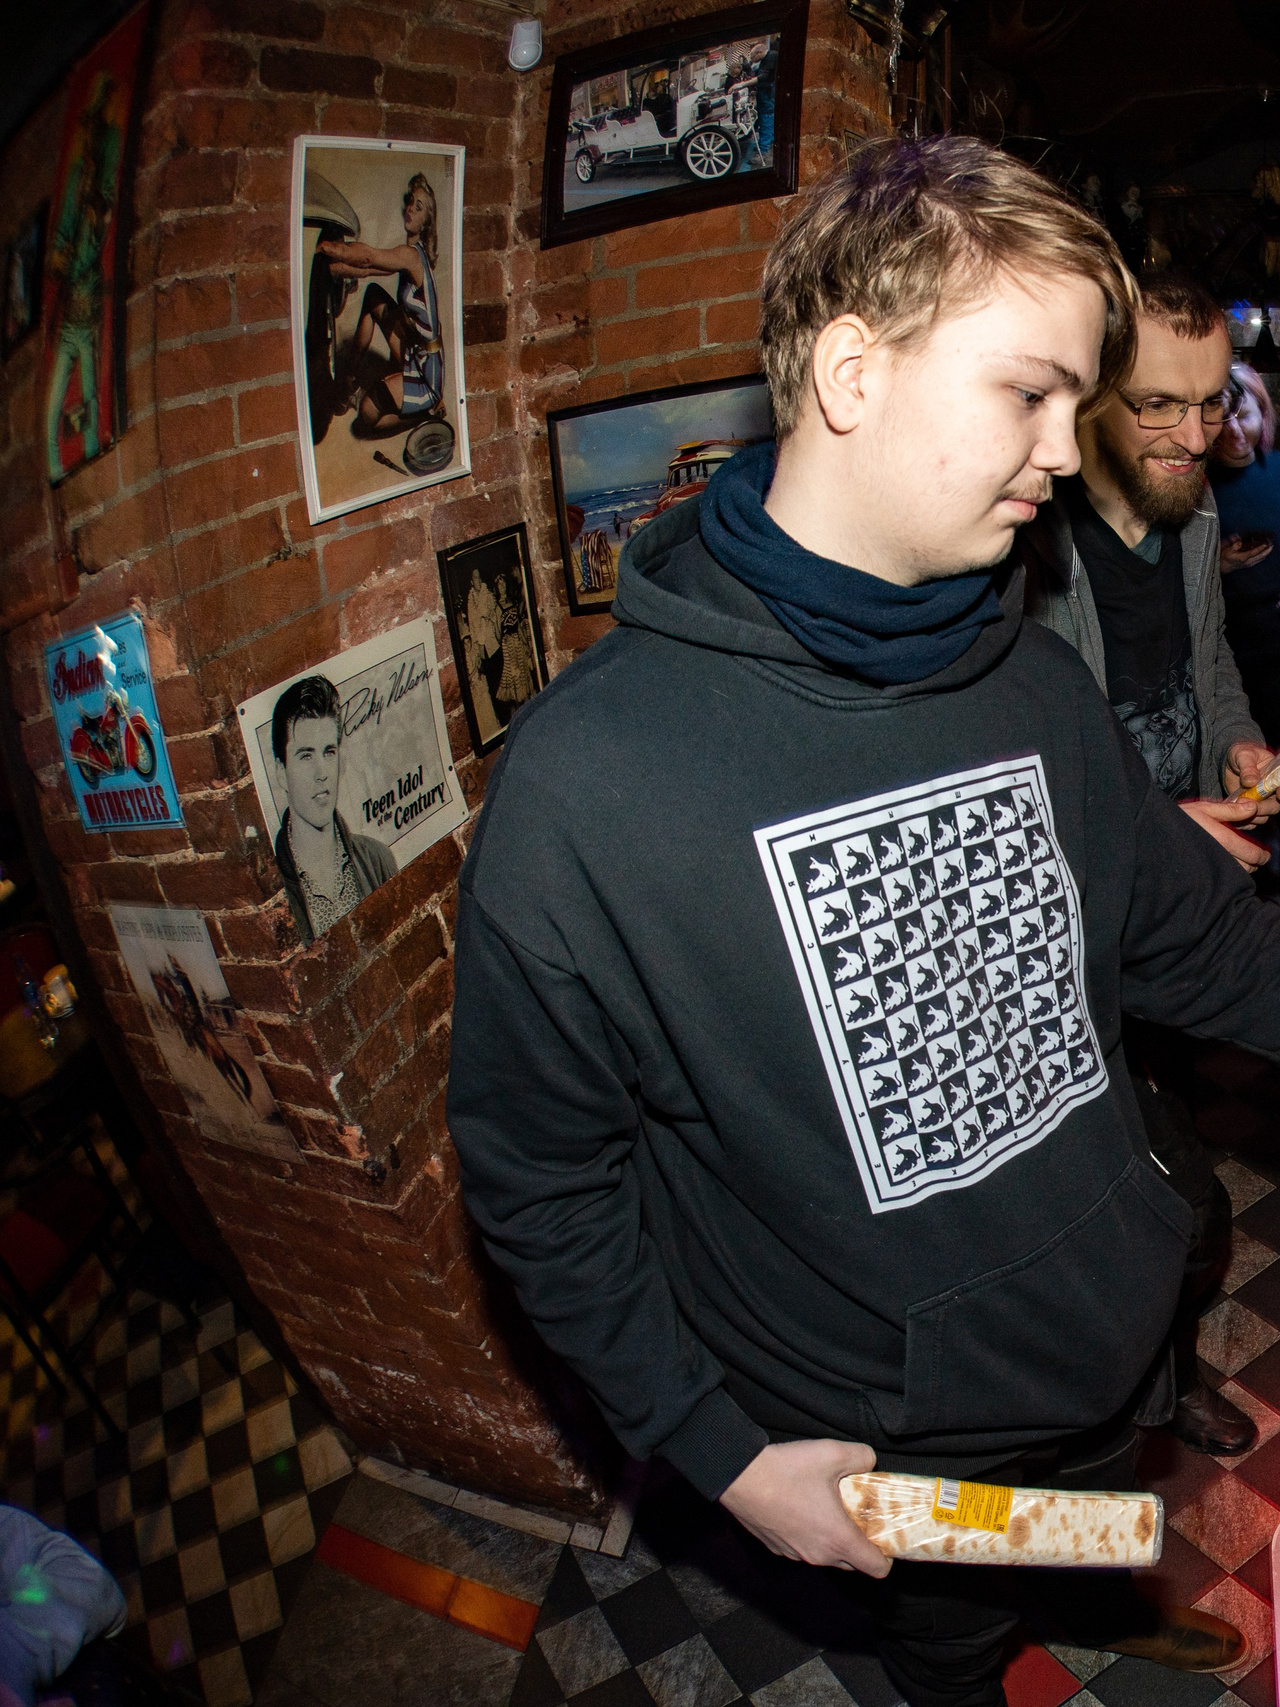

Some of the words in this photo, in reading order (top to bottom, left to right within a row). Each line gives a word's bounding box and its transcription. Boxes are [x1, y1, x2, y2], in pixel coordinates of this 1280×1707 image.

[121, 669, 148, 690] Service
[83, 784, 171, 826] MOTORCYCLES
[362, 789, 396, 824] Teen
[397, 764, 424, 801] Idol
[393, 781, 445, 830] Century
